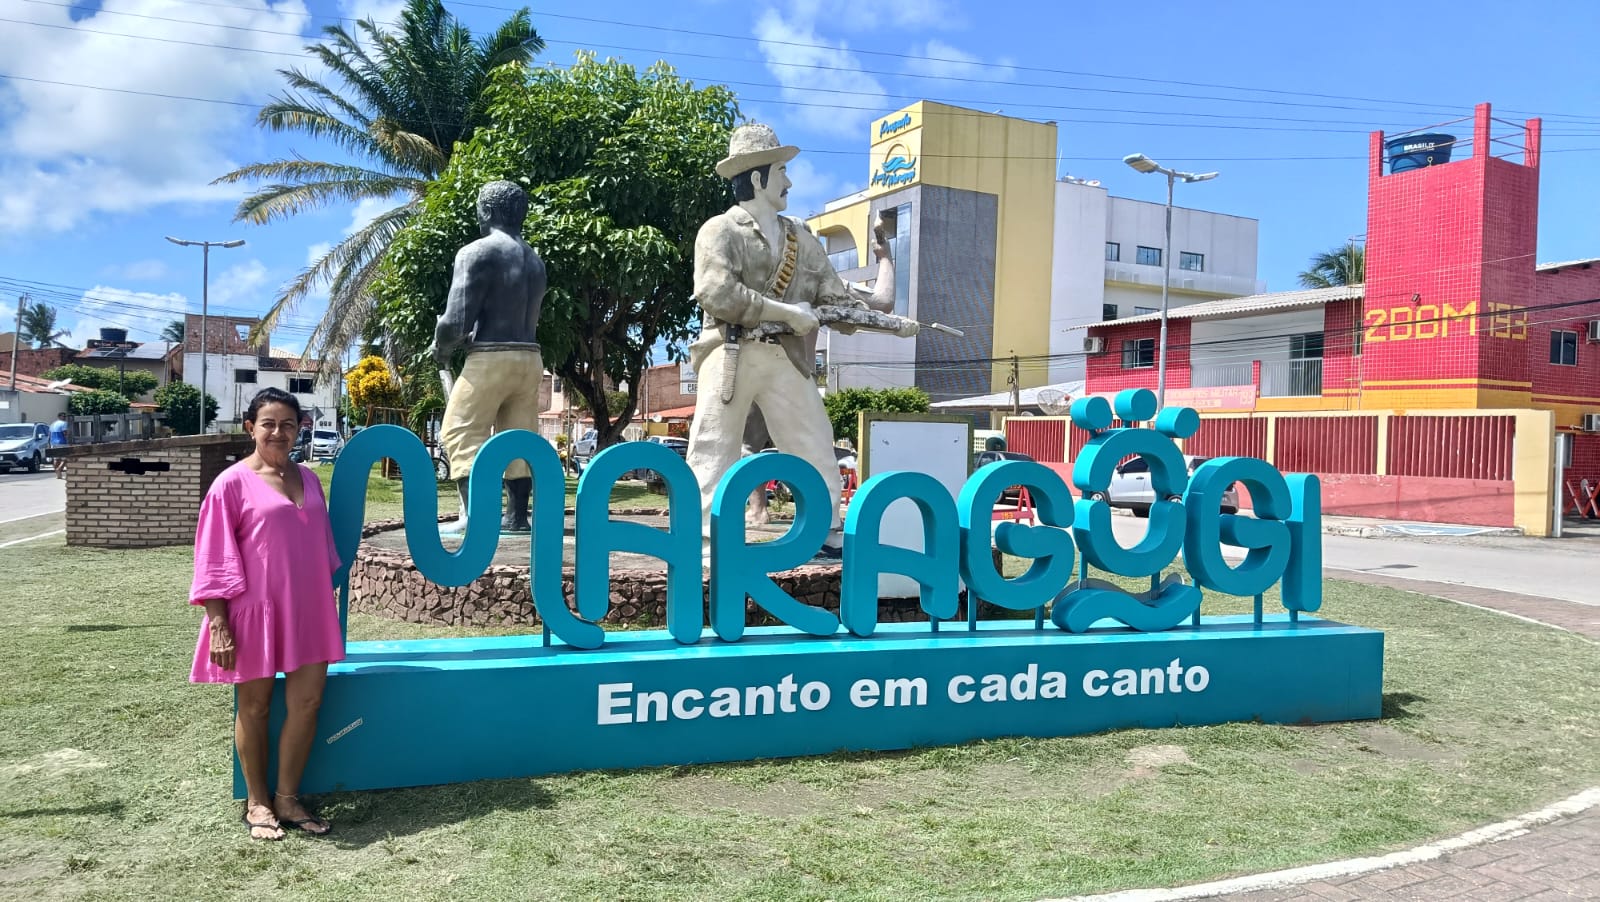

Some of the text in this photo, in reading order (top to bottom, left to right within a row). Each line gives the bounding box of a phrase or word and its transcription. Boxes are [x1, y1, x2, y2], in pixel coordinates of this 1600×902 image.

[1487, 301, 1528, 341] 193
[597, 657, 1210, 725] Encanto em cada canto
